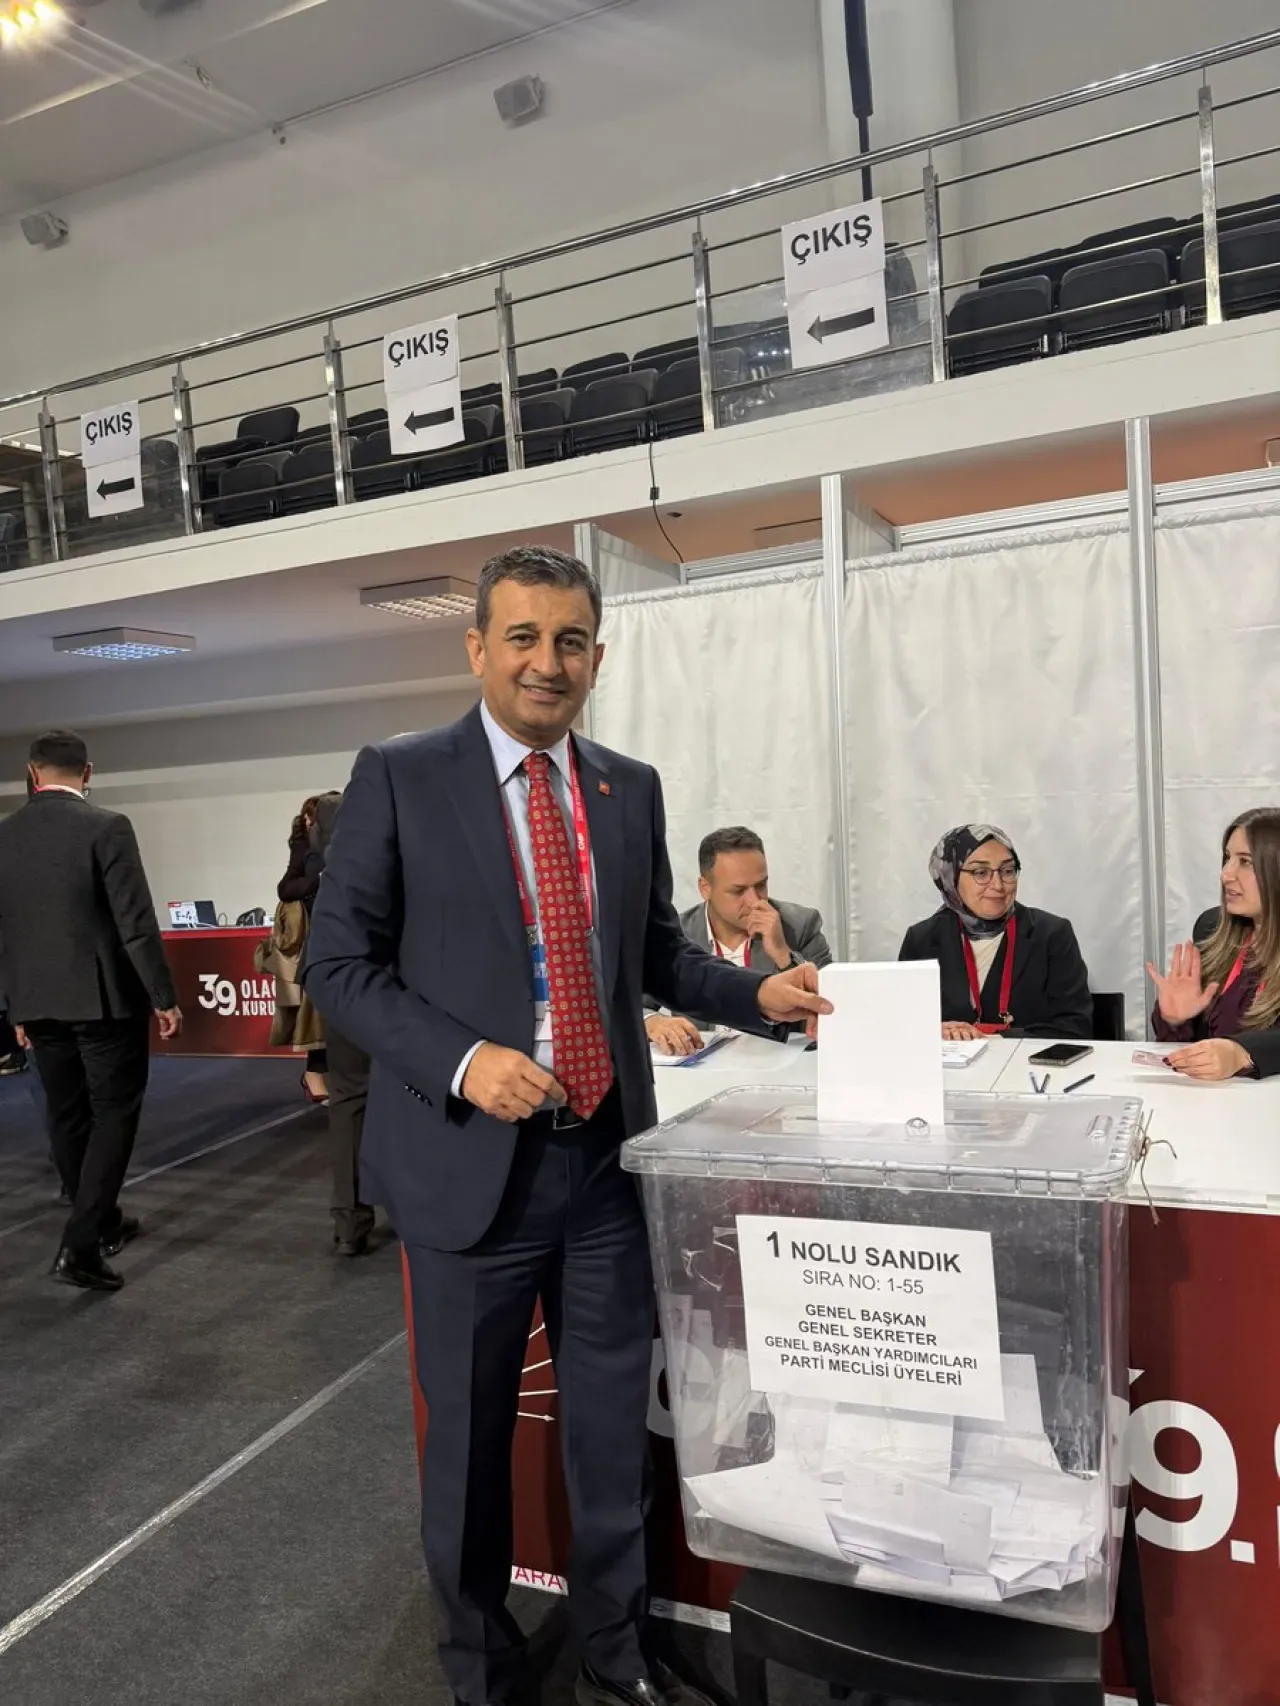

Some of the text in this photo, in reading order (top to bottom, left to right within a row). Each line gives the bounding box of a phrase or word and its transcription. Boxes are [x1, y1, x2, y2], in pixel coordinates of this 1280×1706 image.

[790, 214, 873, 267] ÇIKIŞ
[387, 328, 449, 368] ÇIKIŞ
[85, 411, 133, 446] ÇIKIŞ
[198, 974, 240, 1016] 39.
[766, 1230, 962, 1273] 1 NOLU SANDIK
[802, 1268, 924, 1295] SIRA NO: 1-55
[805, 1303, 927, 1328] GENEL BAŞKAN
[798, 1320, 938, 1347] GENEL SEKRETER
[764, 1335, 978, 1370] GENEL BAŞKAN YARDIMCILARI
[780, 1353, 963, 1387] PARTİ MECLİSİ ÜYELERİ
